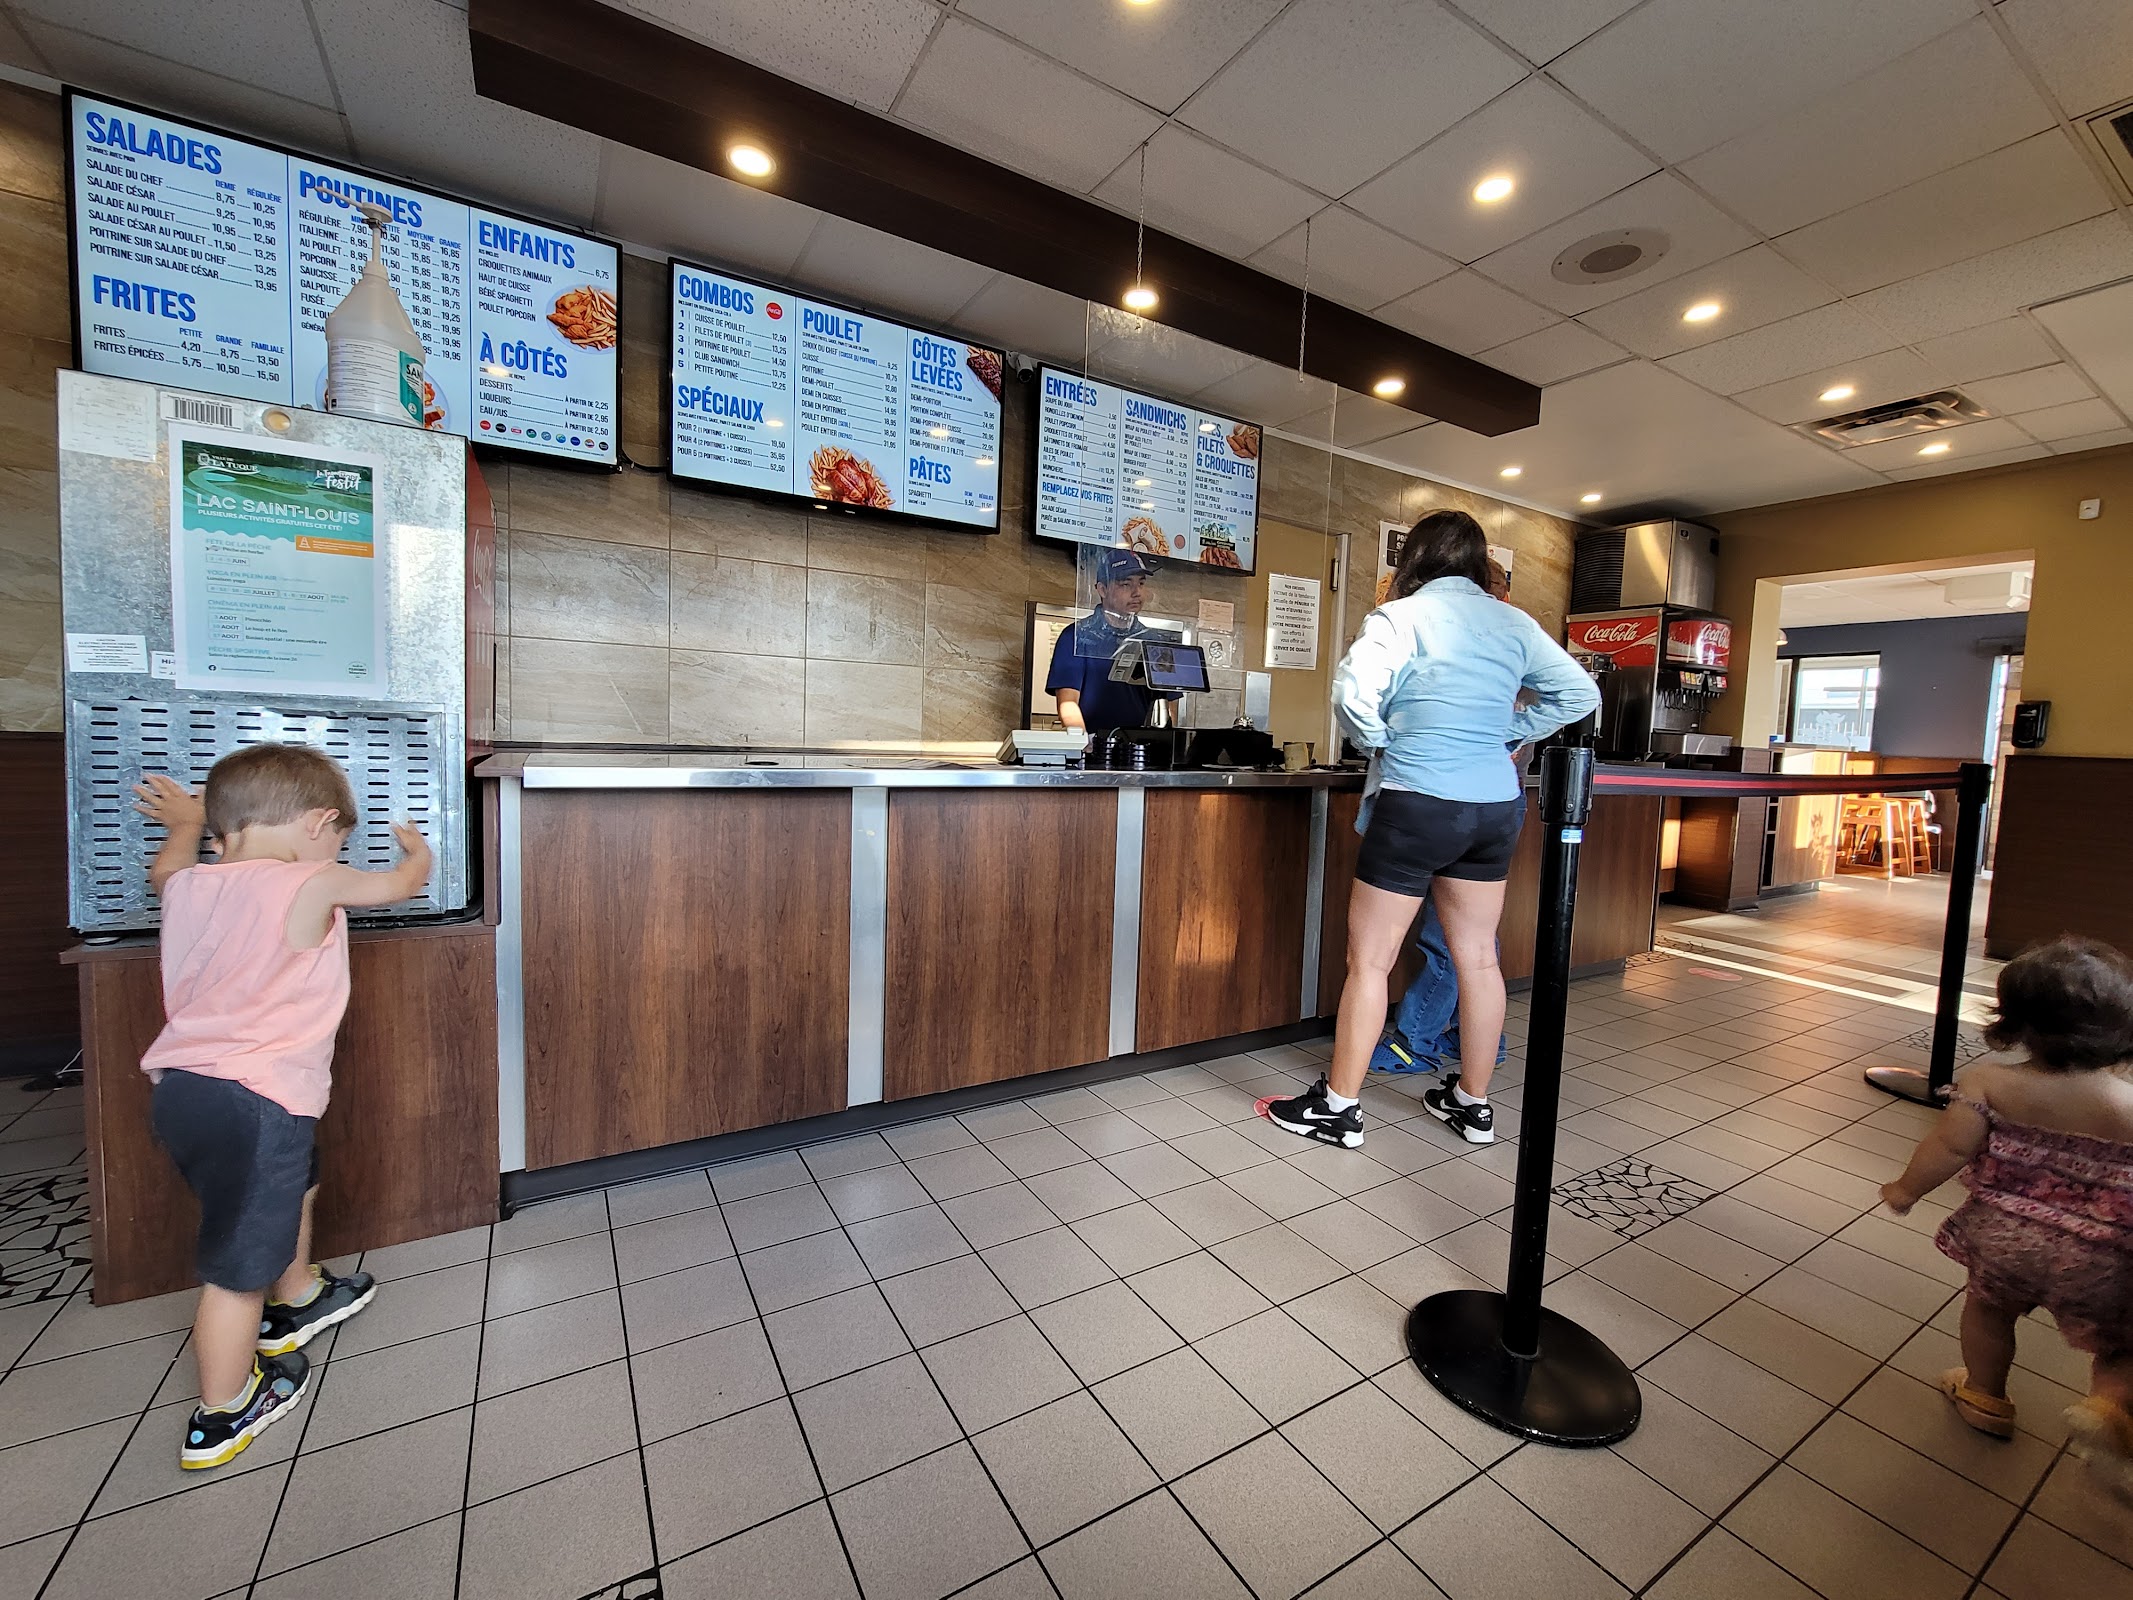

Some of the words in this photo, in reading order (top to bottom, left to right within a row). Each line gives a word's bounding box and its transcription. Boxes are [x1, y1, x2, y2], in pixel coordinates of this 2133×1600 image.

[86, 112, 222, 174] SALADES
[87, 159, 123, 176] SALADE
[126, 169, 138, 179] DU
[141, 173, 163, 186] CHEF
[216, 193, 235, 205] 8,75
[253, 202, 275, 214] 10,25
[215, 179, 236, 191] DEMIE
[247, 188, 282, 204] RÉGULIÈRE
[300, 170, 422, 228] POUTINES
[87, 176, 124, 193] SALADE
[126, 185, 155, 200] CÉSAR
[216, 209, 235, 220] 9,25
[253, 217, 275, 230] 10,95
[88, 192, 124, 209] SALADE
[127, 202, 139, 213] AU
[142, 206, 175, 222] POULET
[212, 223, 236, 236] 10,95
[253, 233, 275, 246] 12,50
[299, 210, 341, 228] RÉGULIÈRE
[351, 224, 367, 234] 7,90
[411, 240, 430, 251] 13,95
[441, 247, 460, 258] 16,85
[89, 209, 125, 226] SALADE
[128, 218, 156, 233] CÉSAR
[159, 226, 171, 236] AU
[173, 230, 206, 245] POULET
[214, 240, 236, 252] 11,50
[254, 248, 276, 262] 13,25
[300, 238, 310, 247] AU
[312, 241, 341, 255] POULET
[300, 224, 339, 241] ITALIENNE
[350, 238, 367, 249] 8,95
[381, 245, 400, 256] 11,50
[411, 253, 431, 264] 15,85
[441, 260, 460, 271] 18,75
[407, 229, 435, 242] MOYENNE
[439, 238, 462, 250] GRANDE
[479, 220, 575, 269] ENFANTS
[89, 226, 133, 243] POITRINE
[135, 236, 152, 249] SUR
[155, 241, 189, 256] SALADE
[191, 249, 202, 259] DU
[205, 253, 226, 265] CHEF
[254, 264, 276, 277] 13,25
[300, 252, 336, 268] POPCORN
[90, 243, 133, 260] POITRINE
[135, 254, 153, 265] SUR
[155, 258, 189, 273] SALADE
[192, 265, 219, 279] CÉSAR
[255, 279, 277, 292] 13,95
[300, 266, 337, 282] SAUCISSE
[479, 258, 521, 275] CROQUETTES
[522, 270, 552, 284] ANIMAUX
[595, 269, 609, 279] 6,75
[93, 274, 196, 322] FRITES
[301, 279, 341, 296] GALPOUTE
[479, 273, 496, 284] HAUT
[498, 277, 506, 286] DE
[508, 280, 531, 293] CUISSE
[479, 287, 496, 299] BÉBÉ
[498, 292, 533, 307] SPAGHETTI
[679, 274, 754, 315] COMBOS
[301, 293, 325, 306] FUSÉE
[301, 307, 311, 316] DE
[479, 302, 504, 314] POULET
[506, 308, 536, 322] POPCORN
[301, 322, 325, 333] GÉNÉRA
[680, 310, 684, 318] 1
[695, 313, 714, 325] CUISSE
[724, 322, 745, 333] POULET
[772, 333, 787, 343] 12,50
[804, 308, 863, 342] POULET
[94, 324, 125, 338] FRITES
[181, 341, 201, 353] 4,20
[221, 348, 239, 360] 8,75
[257, 355, 279, 367] 13,50
[179, 327, 203, 339] PETITE
[216, 334, 243, 346] GRANDE
[251, 341, 284, 354] FAMILIALE
[480, 331, 494, 363] À
[501, 340, 567, 378] CÔTÉS
[678, 335, 684, 343] 3
[694, 338, 720, 352] POITRINE
[722, 345, 729, 353] DE
[730, 347, 751, 359] POULET
[772, 358, 787, 367] 14,50
[694, 326, 713, 338] FILETS
[724, 334, 744, 345] POULET
[772, 346, 787, 355] 13,25
[802, 340, 817, 350] CHOIX
[826, 347, 838, 355] CHEF
[912, 336, 957, 368] CÔTES
[94, 340, 125, 355] FRITES
[129, 345, 165, 362] ÉPICÉES
[182, 357, 202, 368] 5,75
[216, 363, 239, 375] 10,50
[257, 371, 280, 382] 15,50
[678, 360, 684, 368] 5
[694, 364, 714, 375] PETITE
[715, 369, 738, 380] POUTINE
[772, 382, 786, 391] 12,25
[694, 351, 709, 361] CLUB
[711, 355, 740, 368] SANDWICH
[772, 370, 786, 379] 13,75
[912, 361, 963, 391] LEVÉES
[480, 378, 513, 392] DESSERTS
[565, 395, 569, 403] À
[570, 397, 586, 406] PARTIR
[595, 401, 608, 411] 2,25
[802, 376, 834, 390] DEMI-POULET
[1046, 376, 1098, 407] ENTRÉES
[480, 392, 512, 405] LIQUEURS
[595, 415, 608, 424] 2,95
[678, 385, 764, 423] SPÉCIAUX
[1126, 399, 1187, 431] SANDWICHS
[480, 405, 508, 418] EAU/JUS
[595, 427, 608, 436] 2,50
[1197, 436, 1225, 455] FILETS
[211, 459, 222, 468] LA
[224, 461, 258, 472] TUQUE
[910, 456, 951, 484] PÂTES
[1196, 452, 1202, 466] &
[1204, 454, 1255, 479] CROQUETTES
[325, 475, 361, 491] festif
[908, 489, 931, 499] SPAGHETTI
[1042, 482, 1079, 499] REMPLACEZ
[1081, 490, 1092, 500] VOS
[1093, 491, 1113, 504] FRITES
[197, 493, 236, 510] LAC
[243, 499, 360, 525] SAINT-LOUIS
[198, 509, 237, 519] PLUSIEURS
[239, 514, 275, 524] ACTIVITÉS
[276, 518, 313, 528] GRATUITES
[1584, 621, 1641, 643] Coca-Cola
